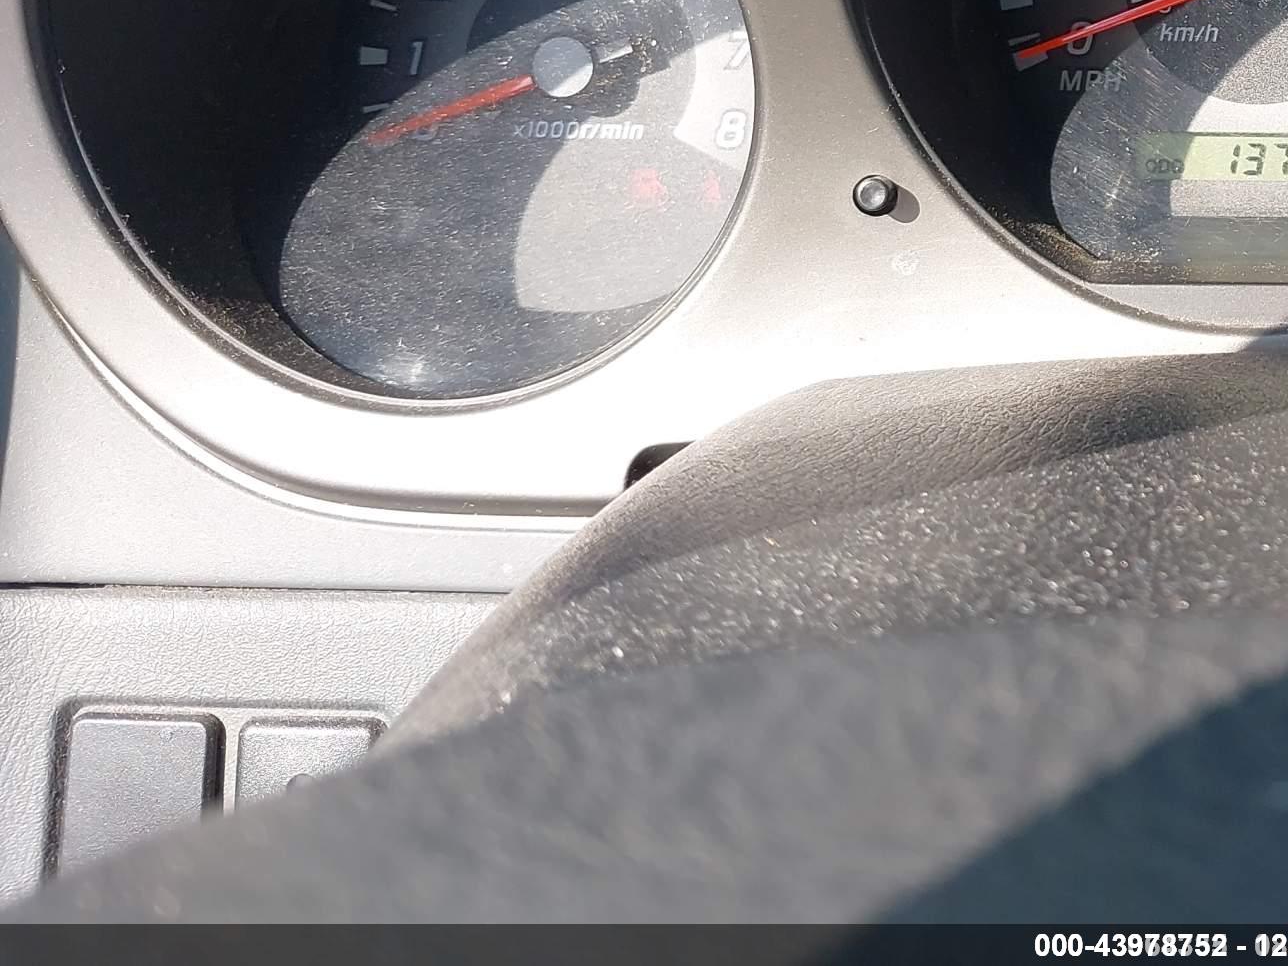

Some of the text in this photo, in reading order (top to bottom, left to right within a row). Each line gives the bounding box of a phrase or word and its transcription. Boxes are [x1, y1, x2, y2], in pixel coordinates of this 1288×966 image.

[1159, 22, 1220, 43] km/h
[409, 42, 424, 76] 1
[1059, 69, 1122, 92] MPH
[716, 109, 747, 149] 8
